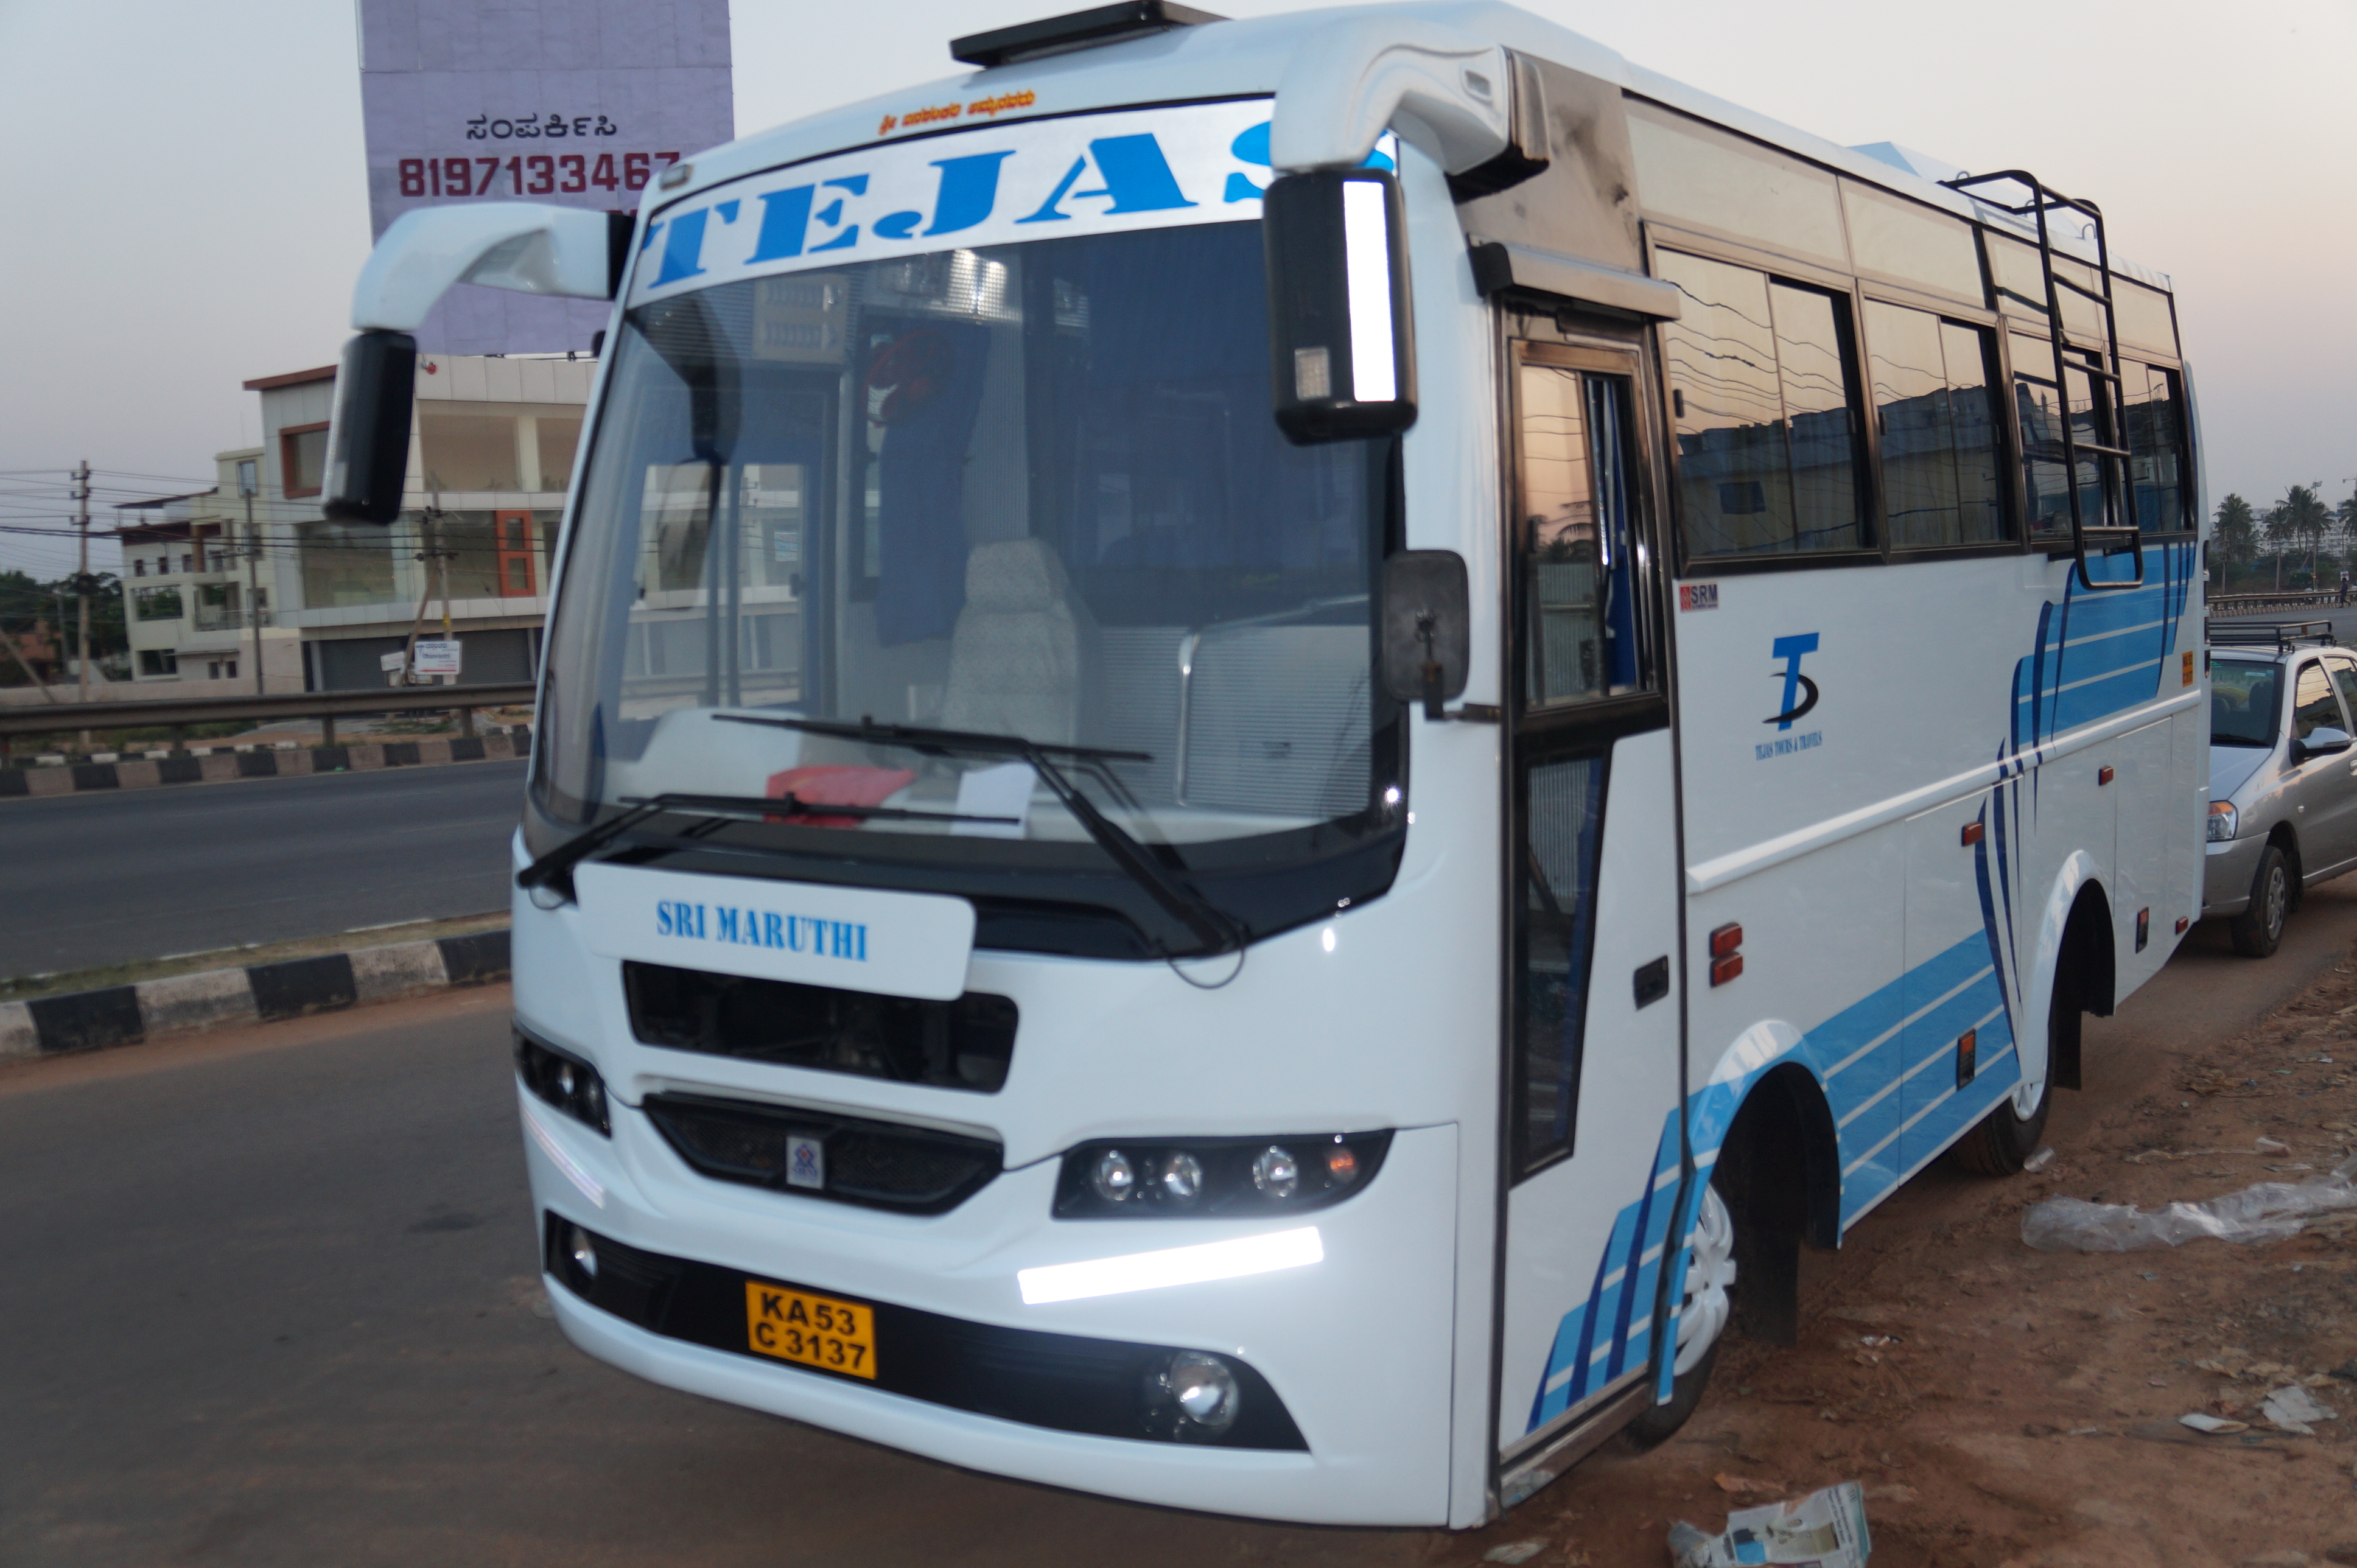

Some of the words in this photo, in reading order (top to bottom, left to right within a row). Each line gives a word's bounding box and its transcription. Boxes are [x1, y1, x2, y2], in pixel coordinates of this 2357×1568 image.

[466, 113, 617, 140] ಸಂಪರ್ಕಿಸಿ
[398, 152, 680, 197] 8197133467
[1690, 584, 1718, 604] SRM
[1755, 743, 1773, 761] TEJAS
[1774, 738, 1793, 757] TOURS
[1799, 731, 1822, 751] TRAVELS
[656, 900, 706, 940] SRI
[715, 906, 867, 962] MARUTHI
[760, 1291, 856, 1337] KA53
[785, 1329, 867, 1370] 3137
